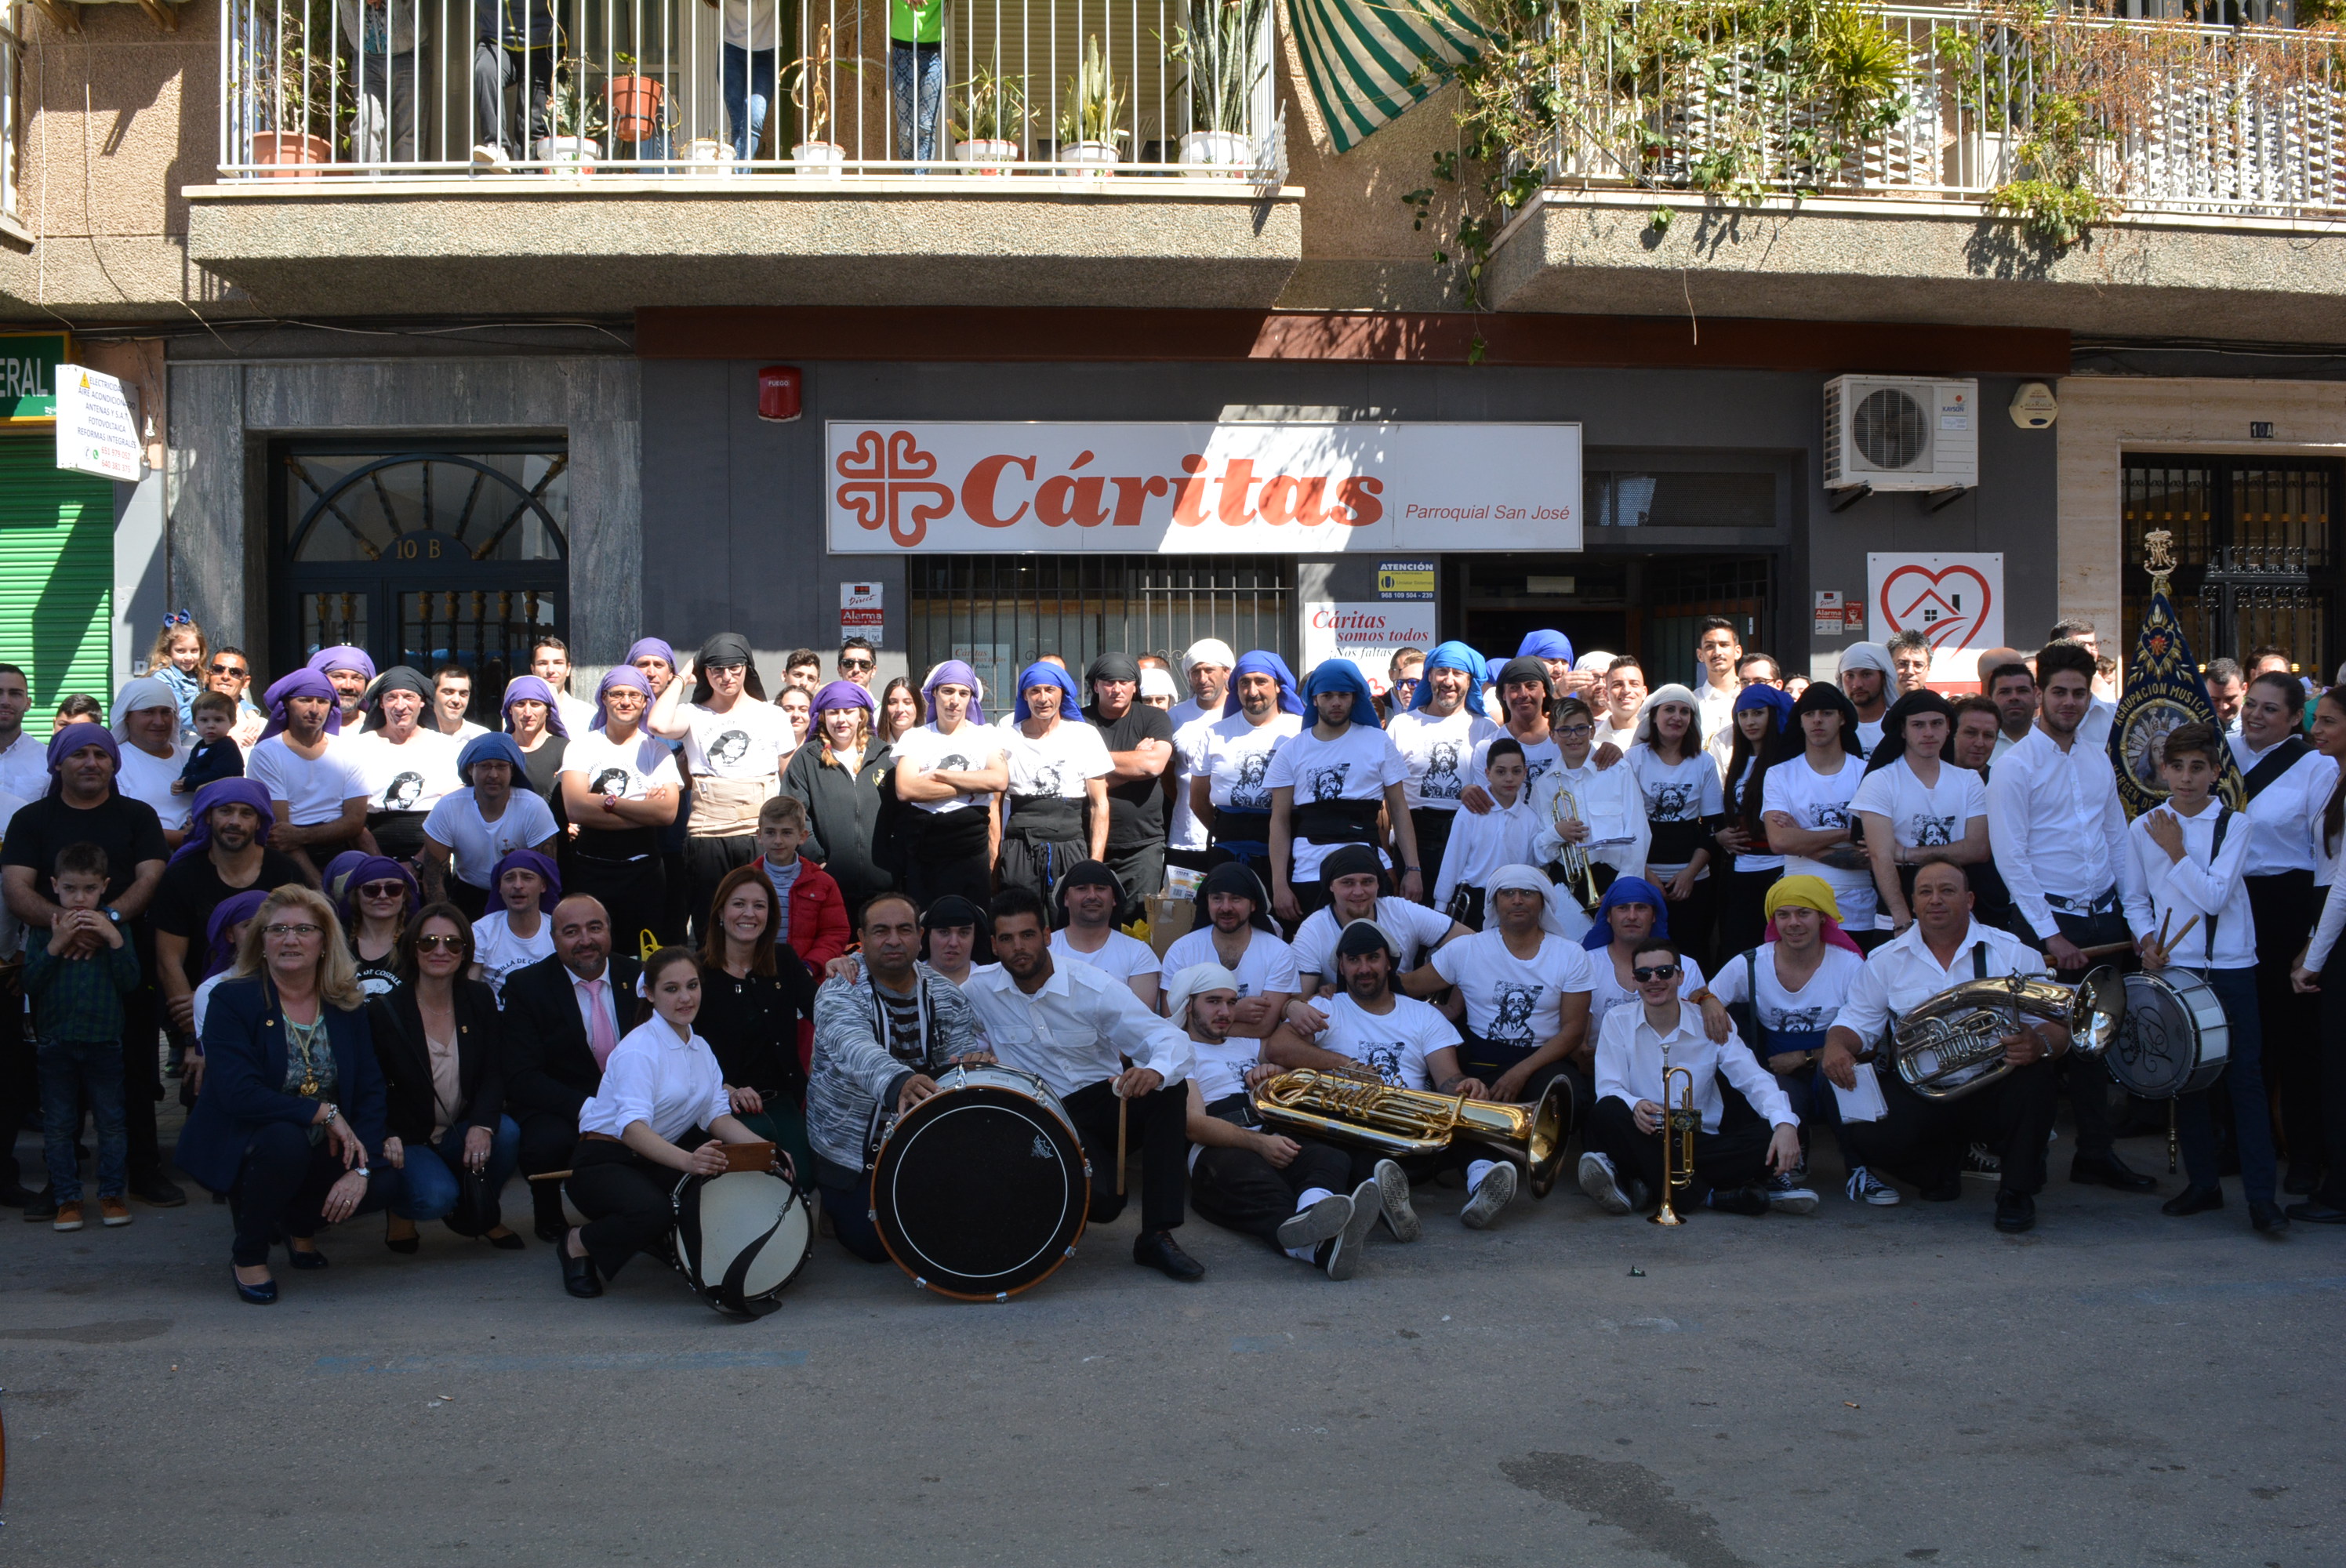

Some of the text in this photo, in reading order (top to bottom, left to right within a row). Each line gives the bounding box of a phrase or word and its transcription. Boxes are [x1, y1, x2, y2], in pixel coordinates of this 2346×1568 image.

[89, 376, 125, 393] ELECTRICIDAD
[78, 387, 136, 410] AIRE ACONDICIONADO
[85, 402, 110, 416] ANTENAS
[89, 416, 126, 434] FOTOVOLTAICA
[78, 427, 136, 449] REFORMAS INTEGRALES
[101, 446, 111, 455] 651
[101, 460, 111, 469] 640
[961, 449, 1383, 528] Cáritas
[1406, 504, 1570, 522] Parroquial San José
[396, 539, 441, 559] 10 B
[1380, 561, 1434, 571] ATENCIÓN
[849, 594, 877, 606] Direct
[843, 611, 882, 620] Alarma
[1313, 610, 1386, 629] Cáritas
[1337, 628, 1429, 642] somos todos
[955, 648, 988, 657] Cártas
[1358, 647, 1393, 661] faltas
[2113, 682, 2215, 727] AGRUPACION MUSICAL
[2113, 764, 2154, 810] VIRGEN DE
